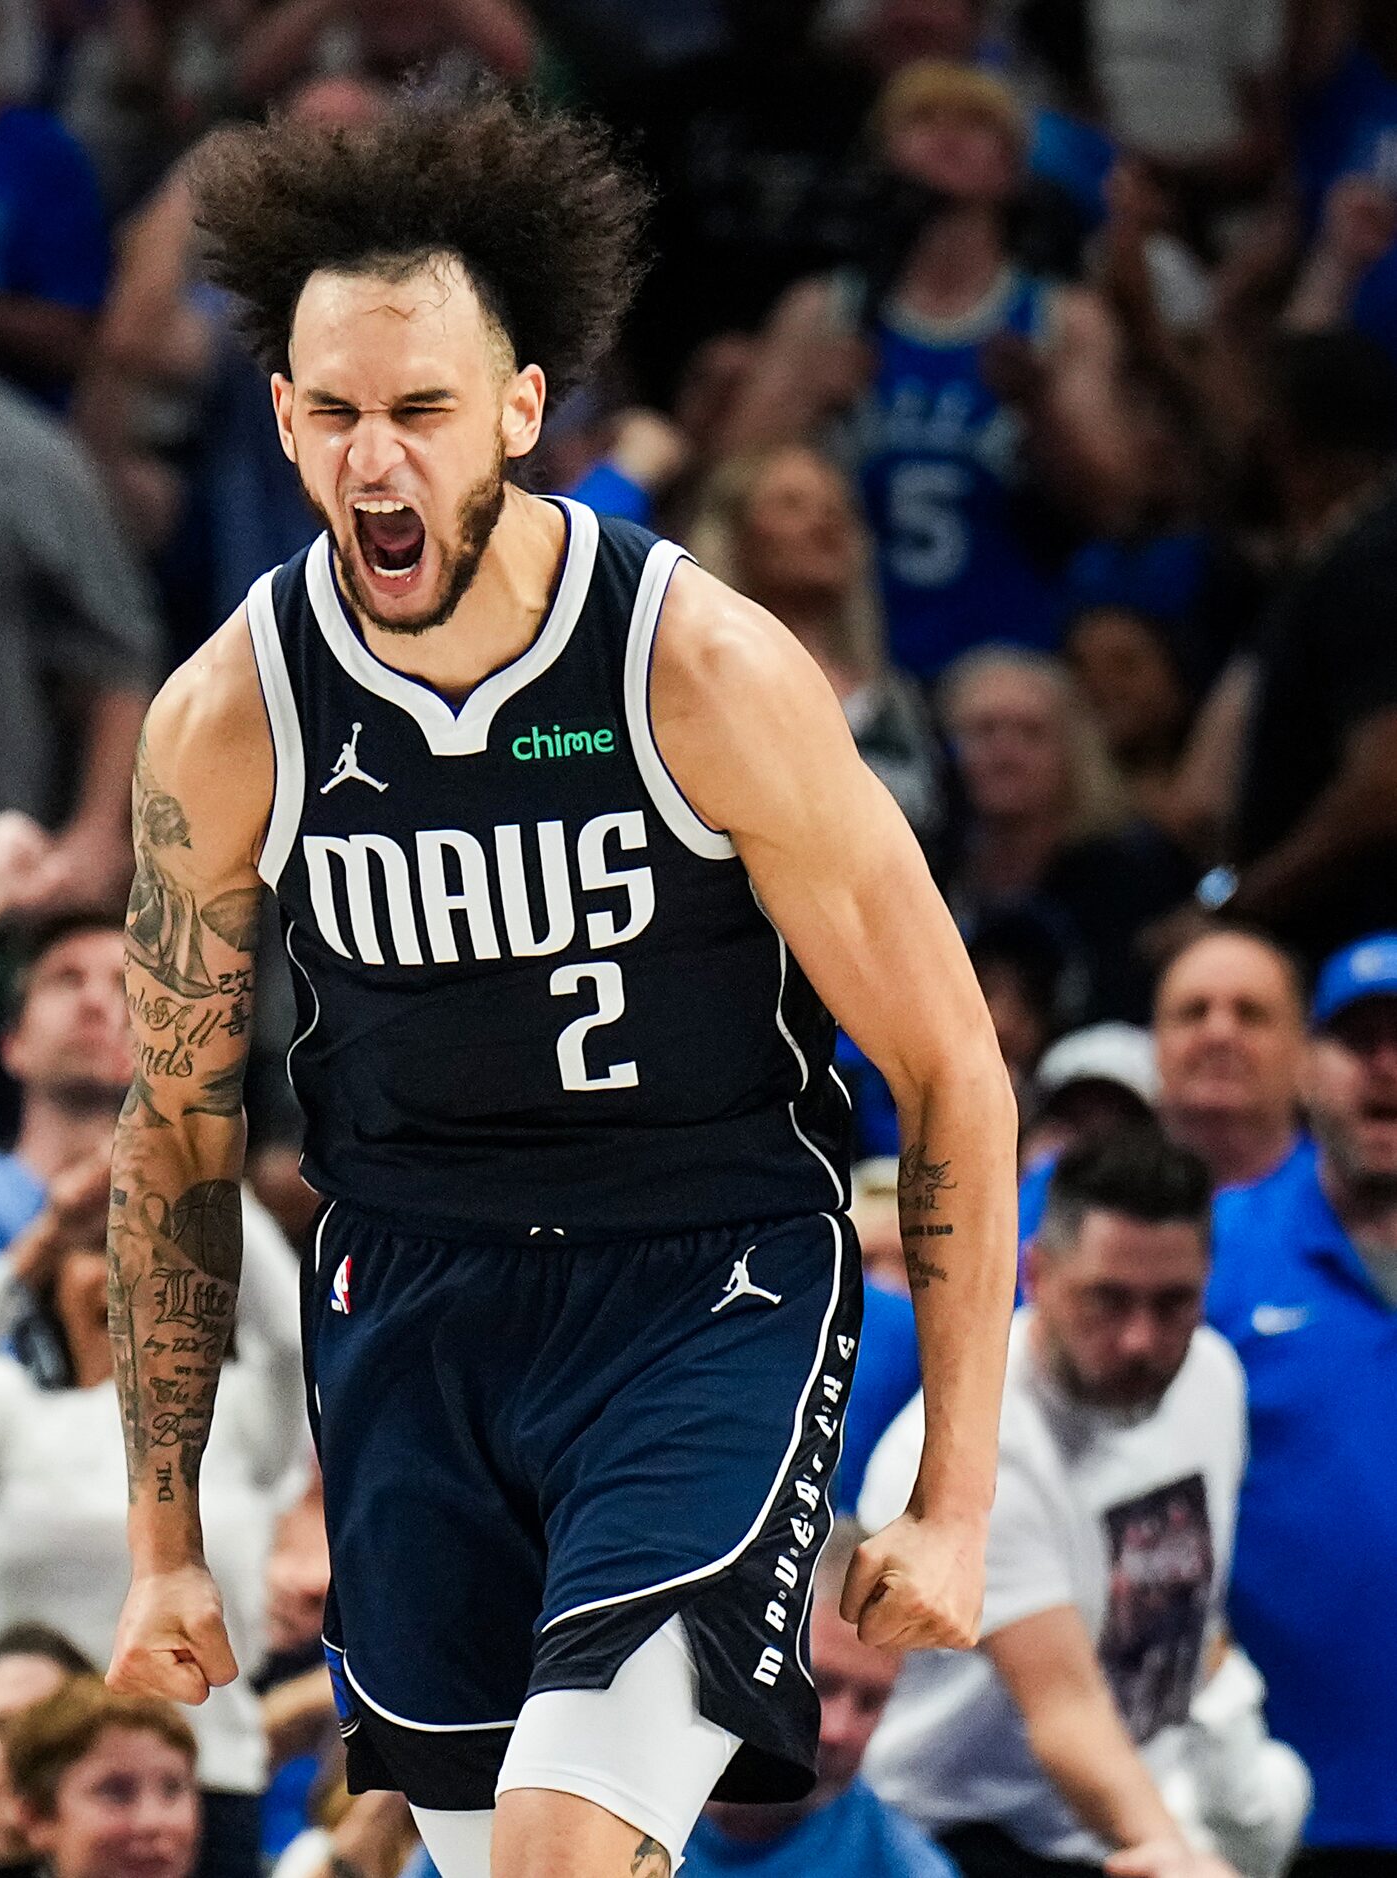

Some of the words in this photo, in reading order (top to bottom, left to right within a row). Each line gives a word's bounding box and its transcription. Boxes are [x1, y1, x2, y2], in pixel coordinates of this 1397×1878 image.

[512, 724, 615, 761] chime
[302, 811, 656, 965] MAVS
[549, 961, 639, 1091] 2
